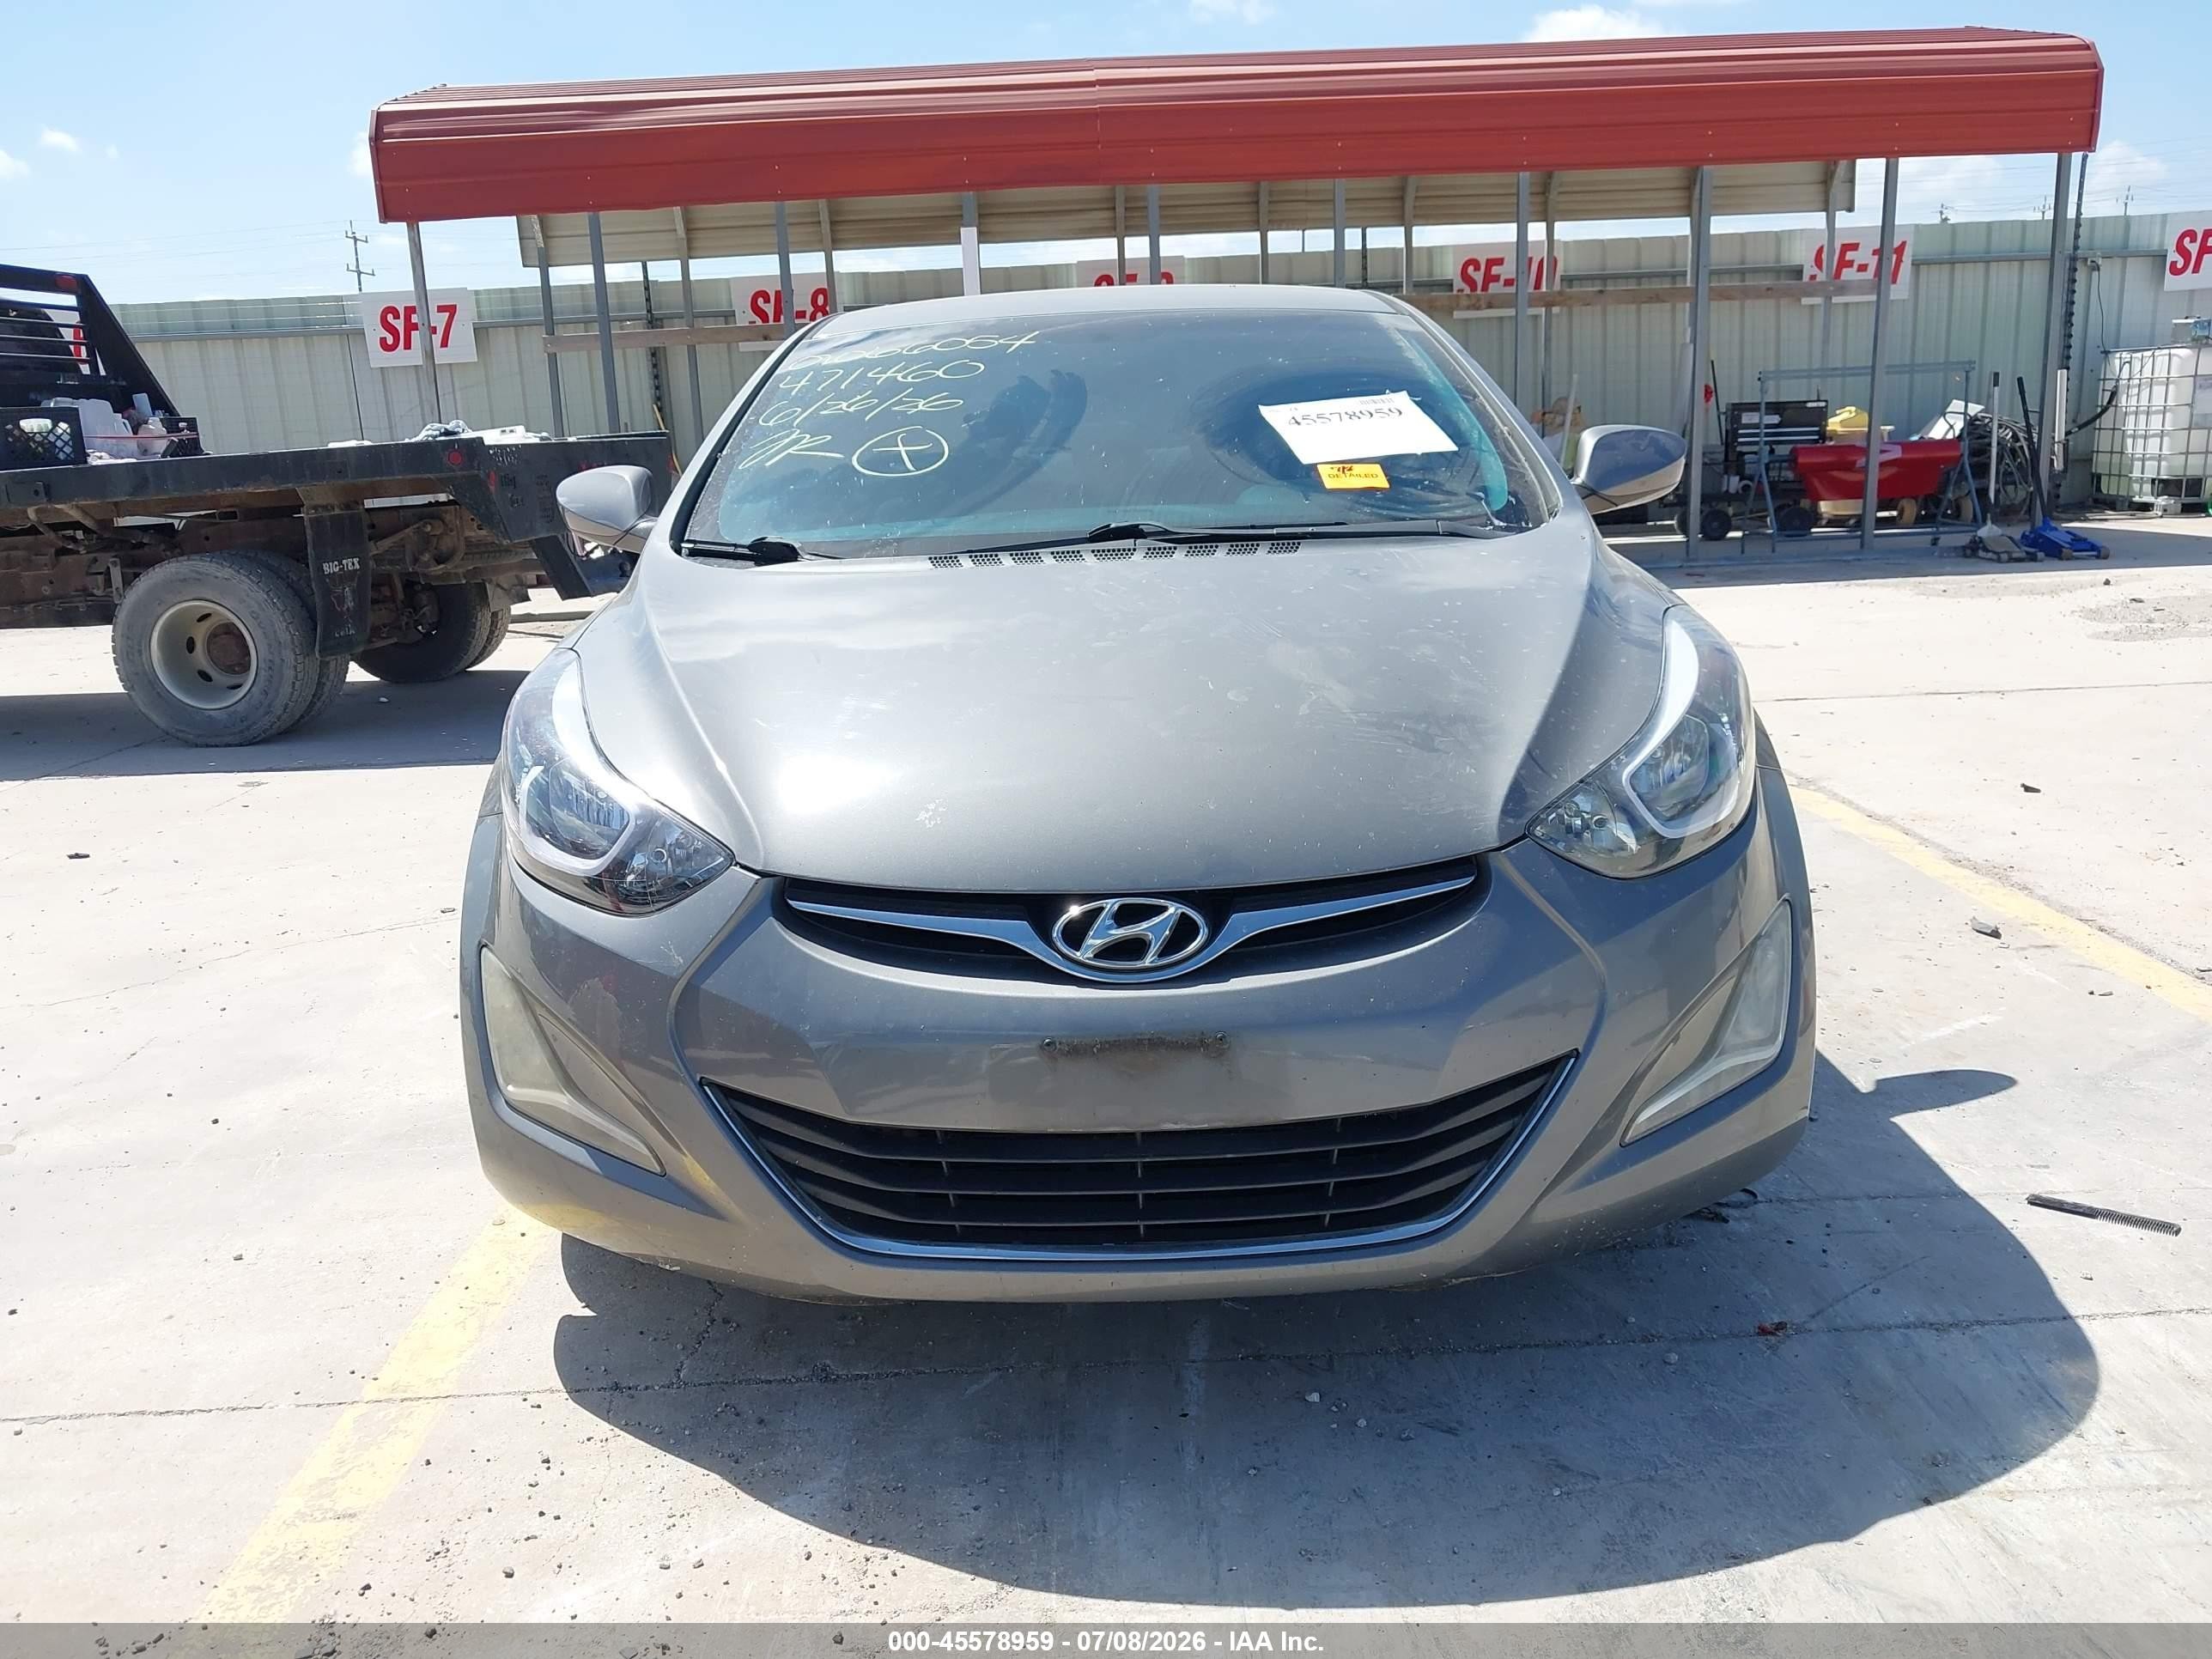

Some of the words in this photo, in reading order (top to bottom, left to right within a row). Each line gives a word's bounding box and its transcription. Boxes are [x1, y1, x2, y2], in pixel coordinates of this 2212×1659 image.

[379, 303, 458, 353] SF-7
[1288, 407, 1403, 426] 45578959
[322, 557, 361, 574] BIG-TEX
